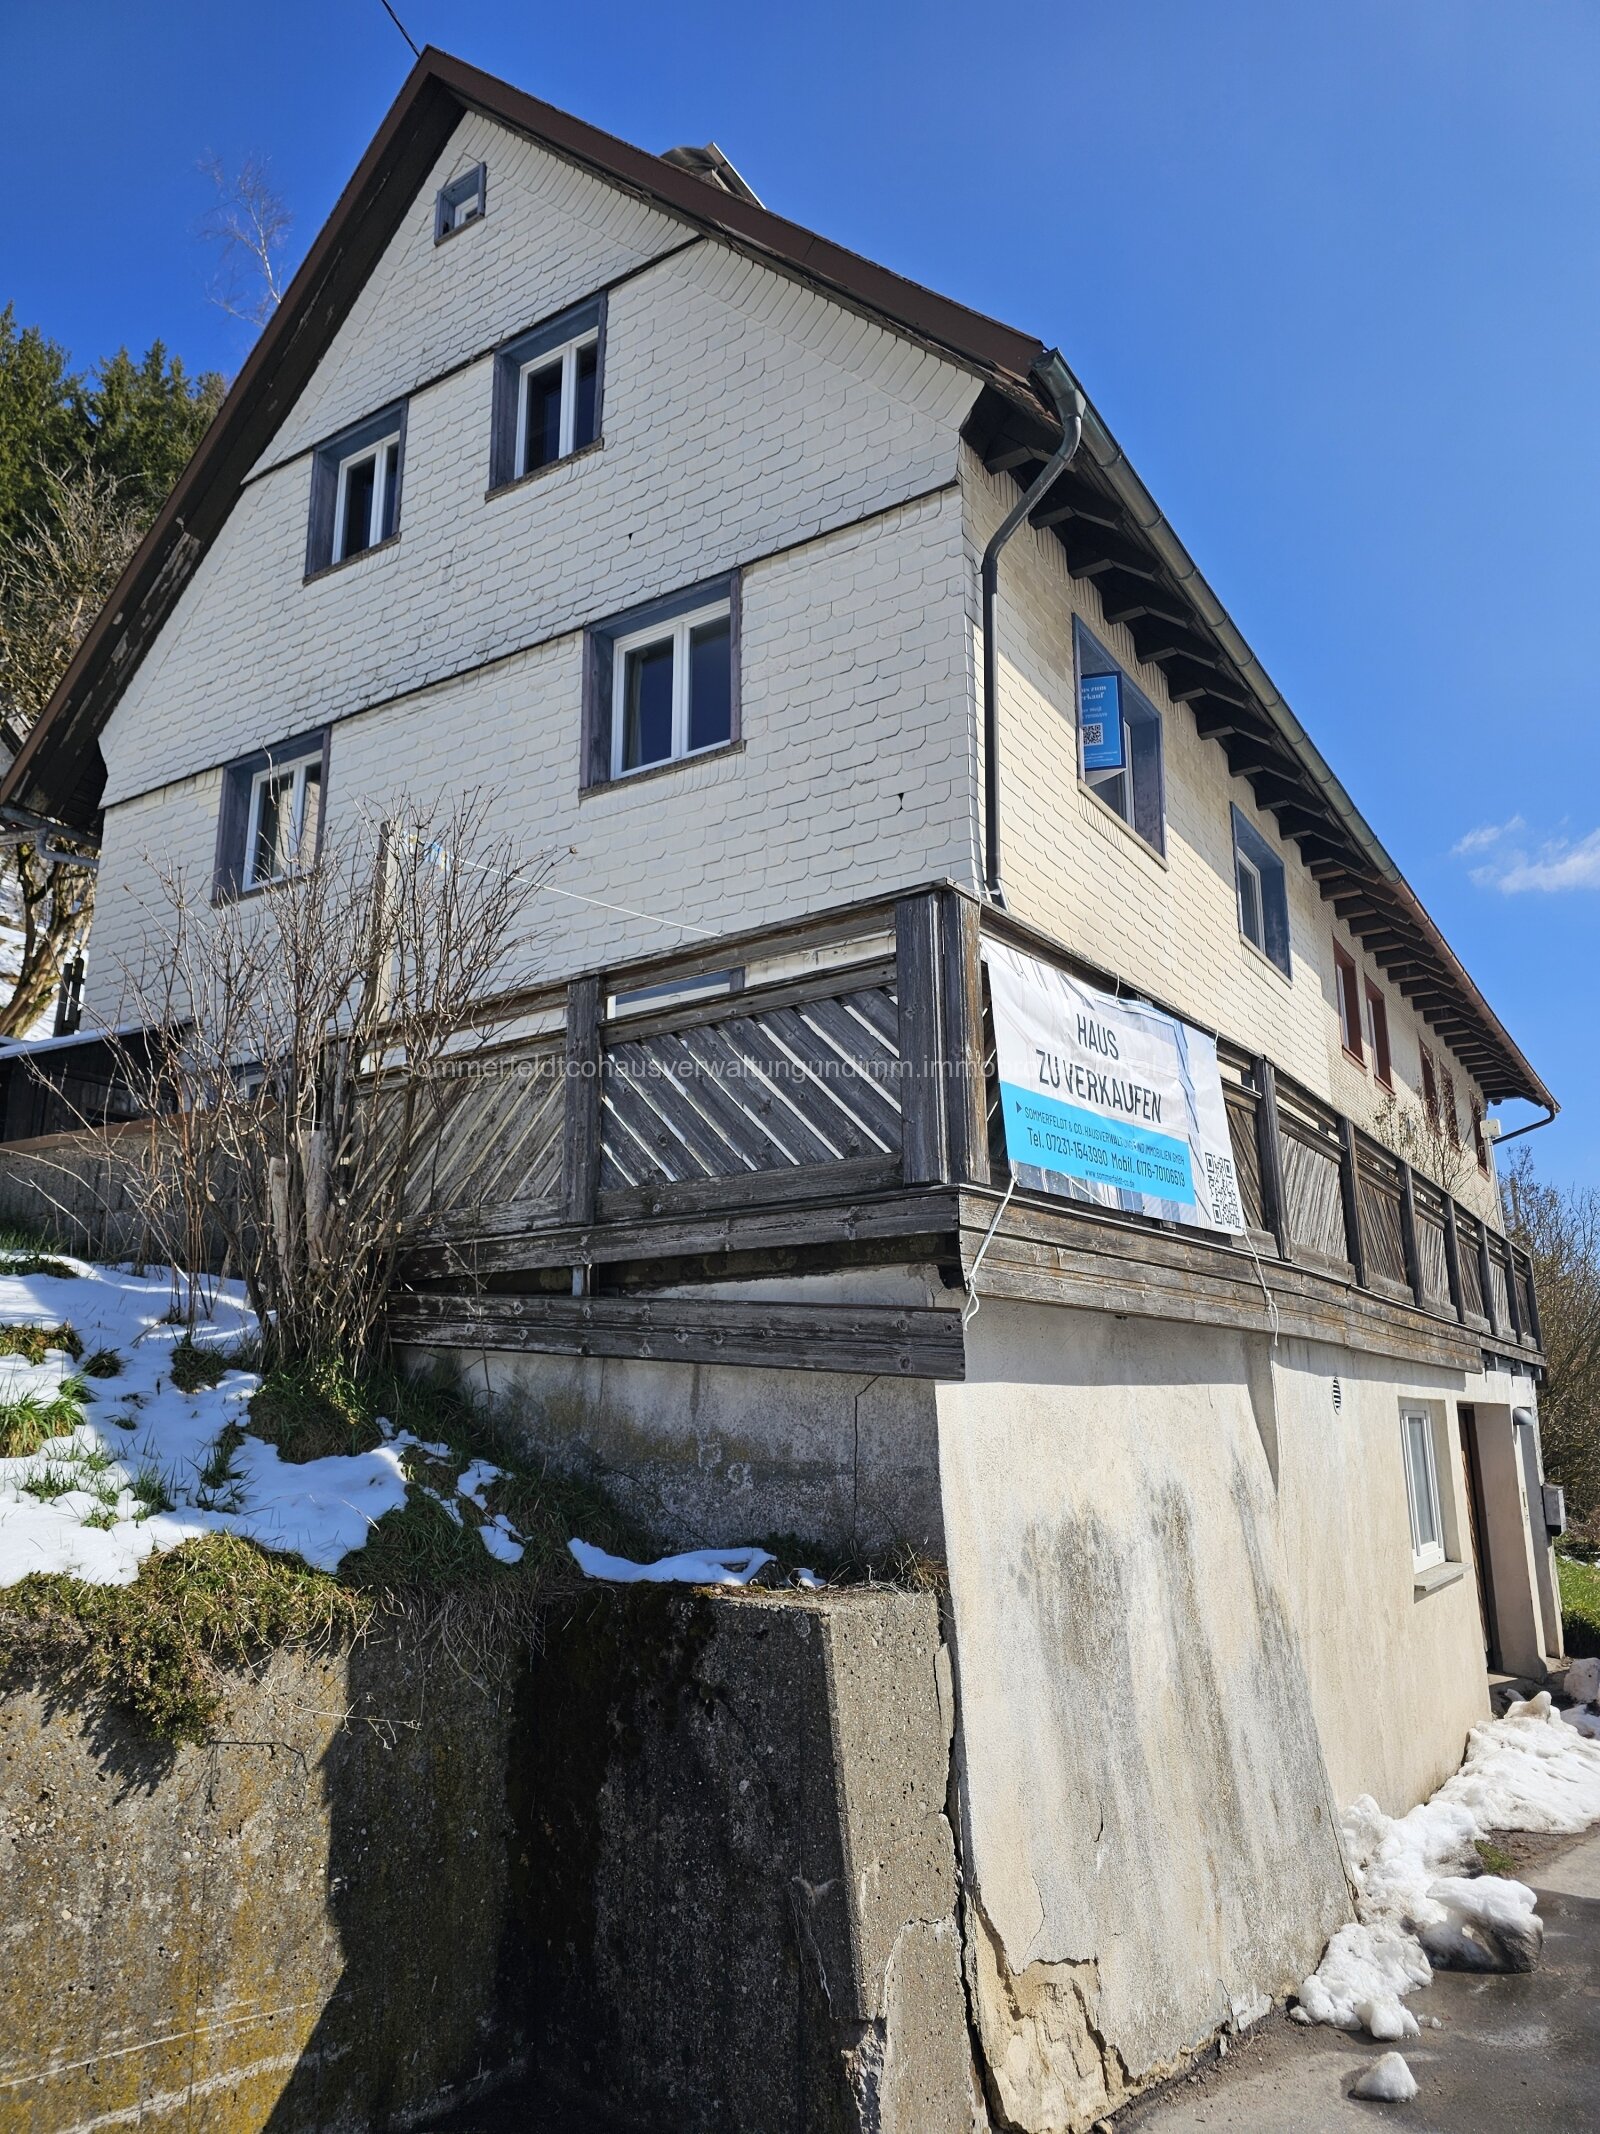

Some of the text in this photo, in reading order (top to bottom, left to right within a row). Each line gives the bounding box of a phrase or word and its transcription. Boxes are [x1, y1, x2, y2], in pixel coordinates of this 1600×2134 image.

[1076, 1013, 1119, 1060] HAUS
[1036, 1049, 1162, 1124] ZU VERKAUFEN
[1025, 1106, 1068, 1130] SOMMERFELDT
[1073, 1122, 1084, 1136] CO.
[1145, 1143, 1172, 1162] IMMOBILIEN
[1027, 1127, 1186, 1188] Tel. 07231-1543990 Mobil. 0176-70106519
